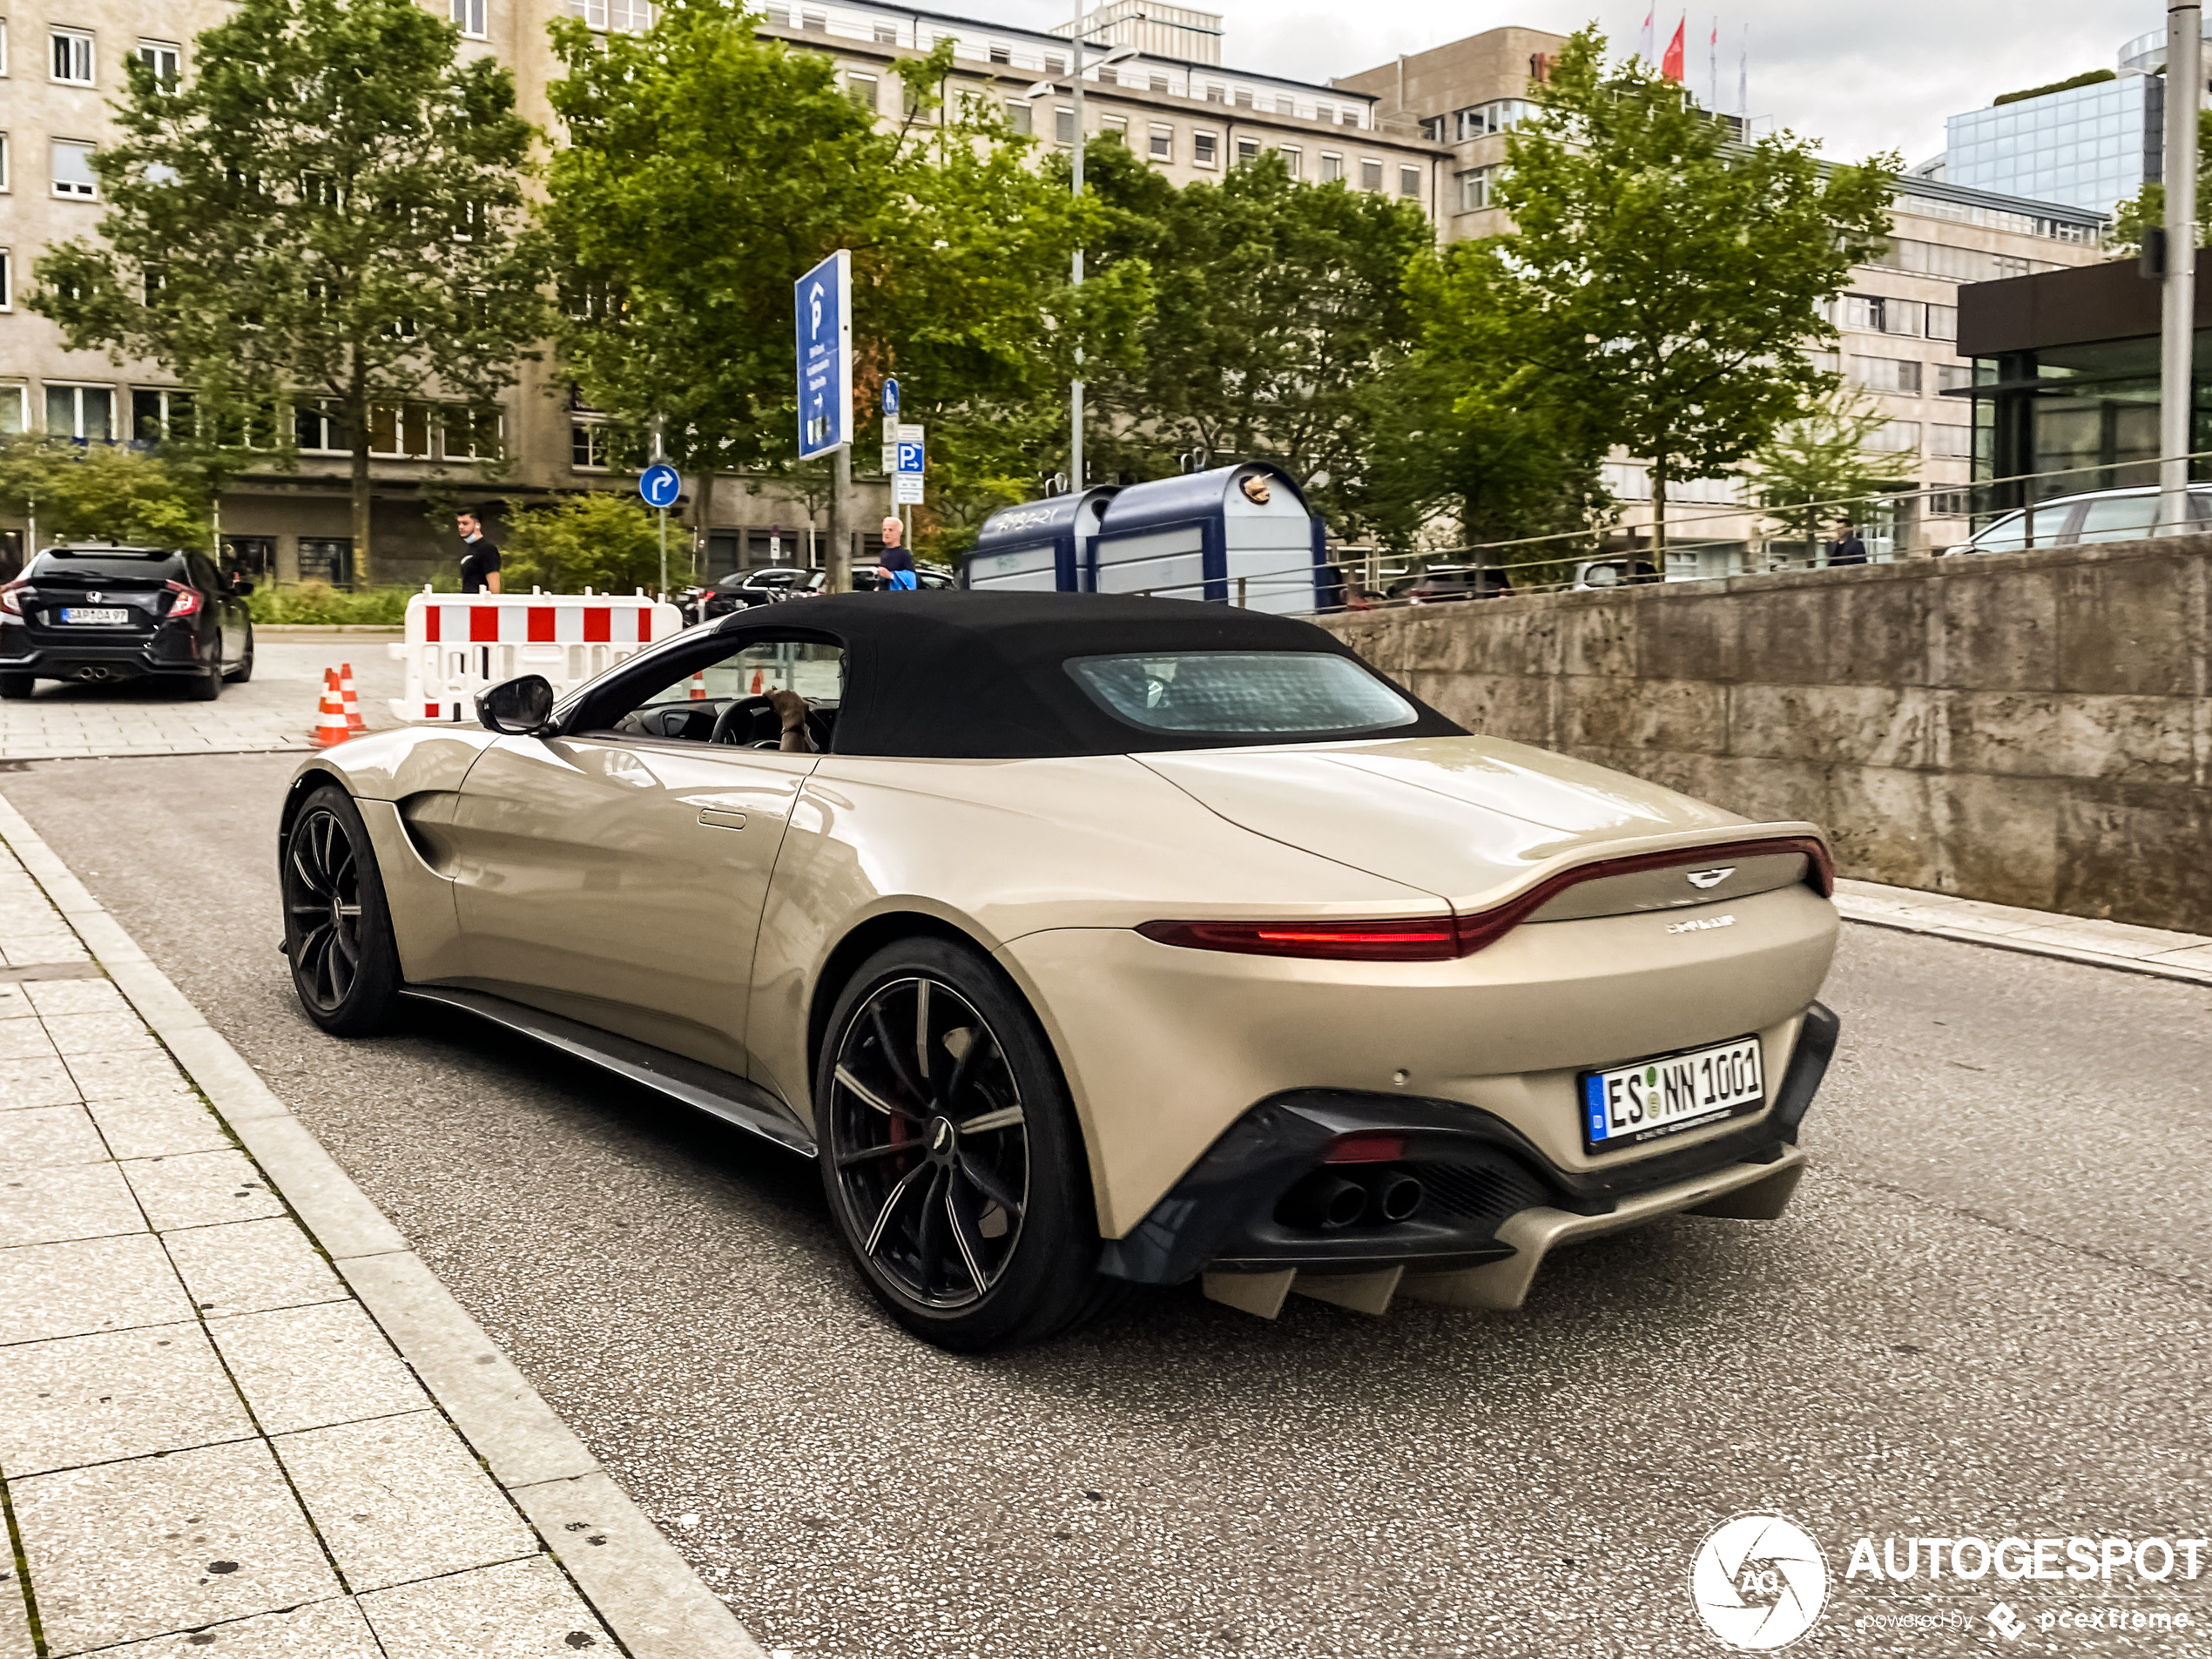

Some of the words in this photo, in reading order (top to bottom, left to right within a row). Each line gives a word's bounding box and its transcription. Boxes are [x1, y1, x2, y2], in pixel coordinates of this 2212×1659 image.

[812, 300, 822, 341] P
[900, 445, 916, 469] P
[1608, 1074, 1644, 1129] ES
[1662, 1062, 1697, 1116] NN
[1702, 1047, 1759, 1105] 1001
